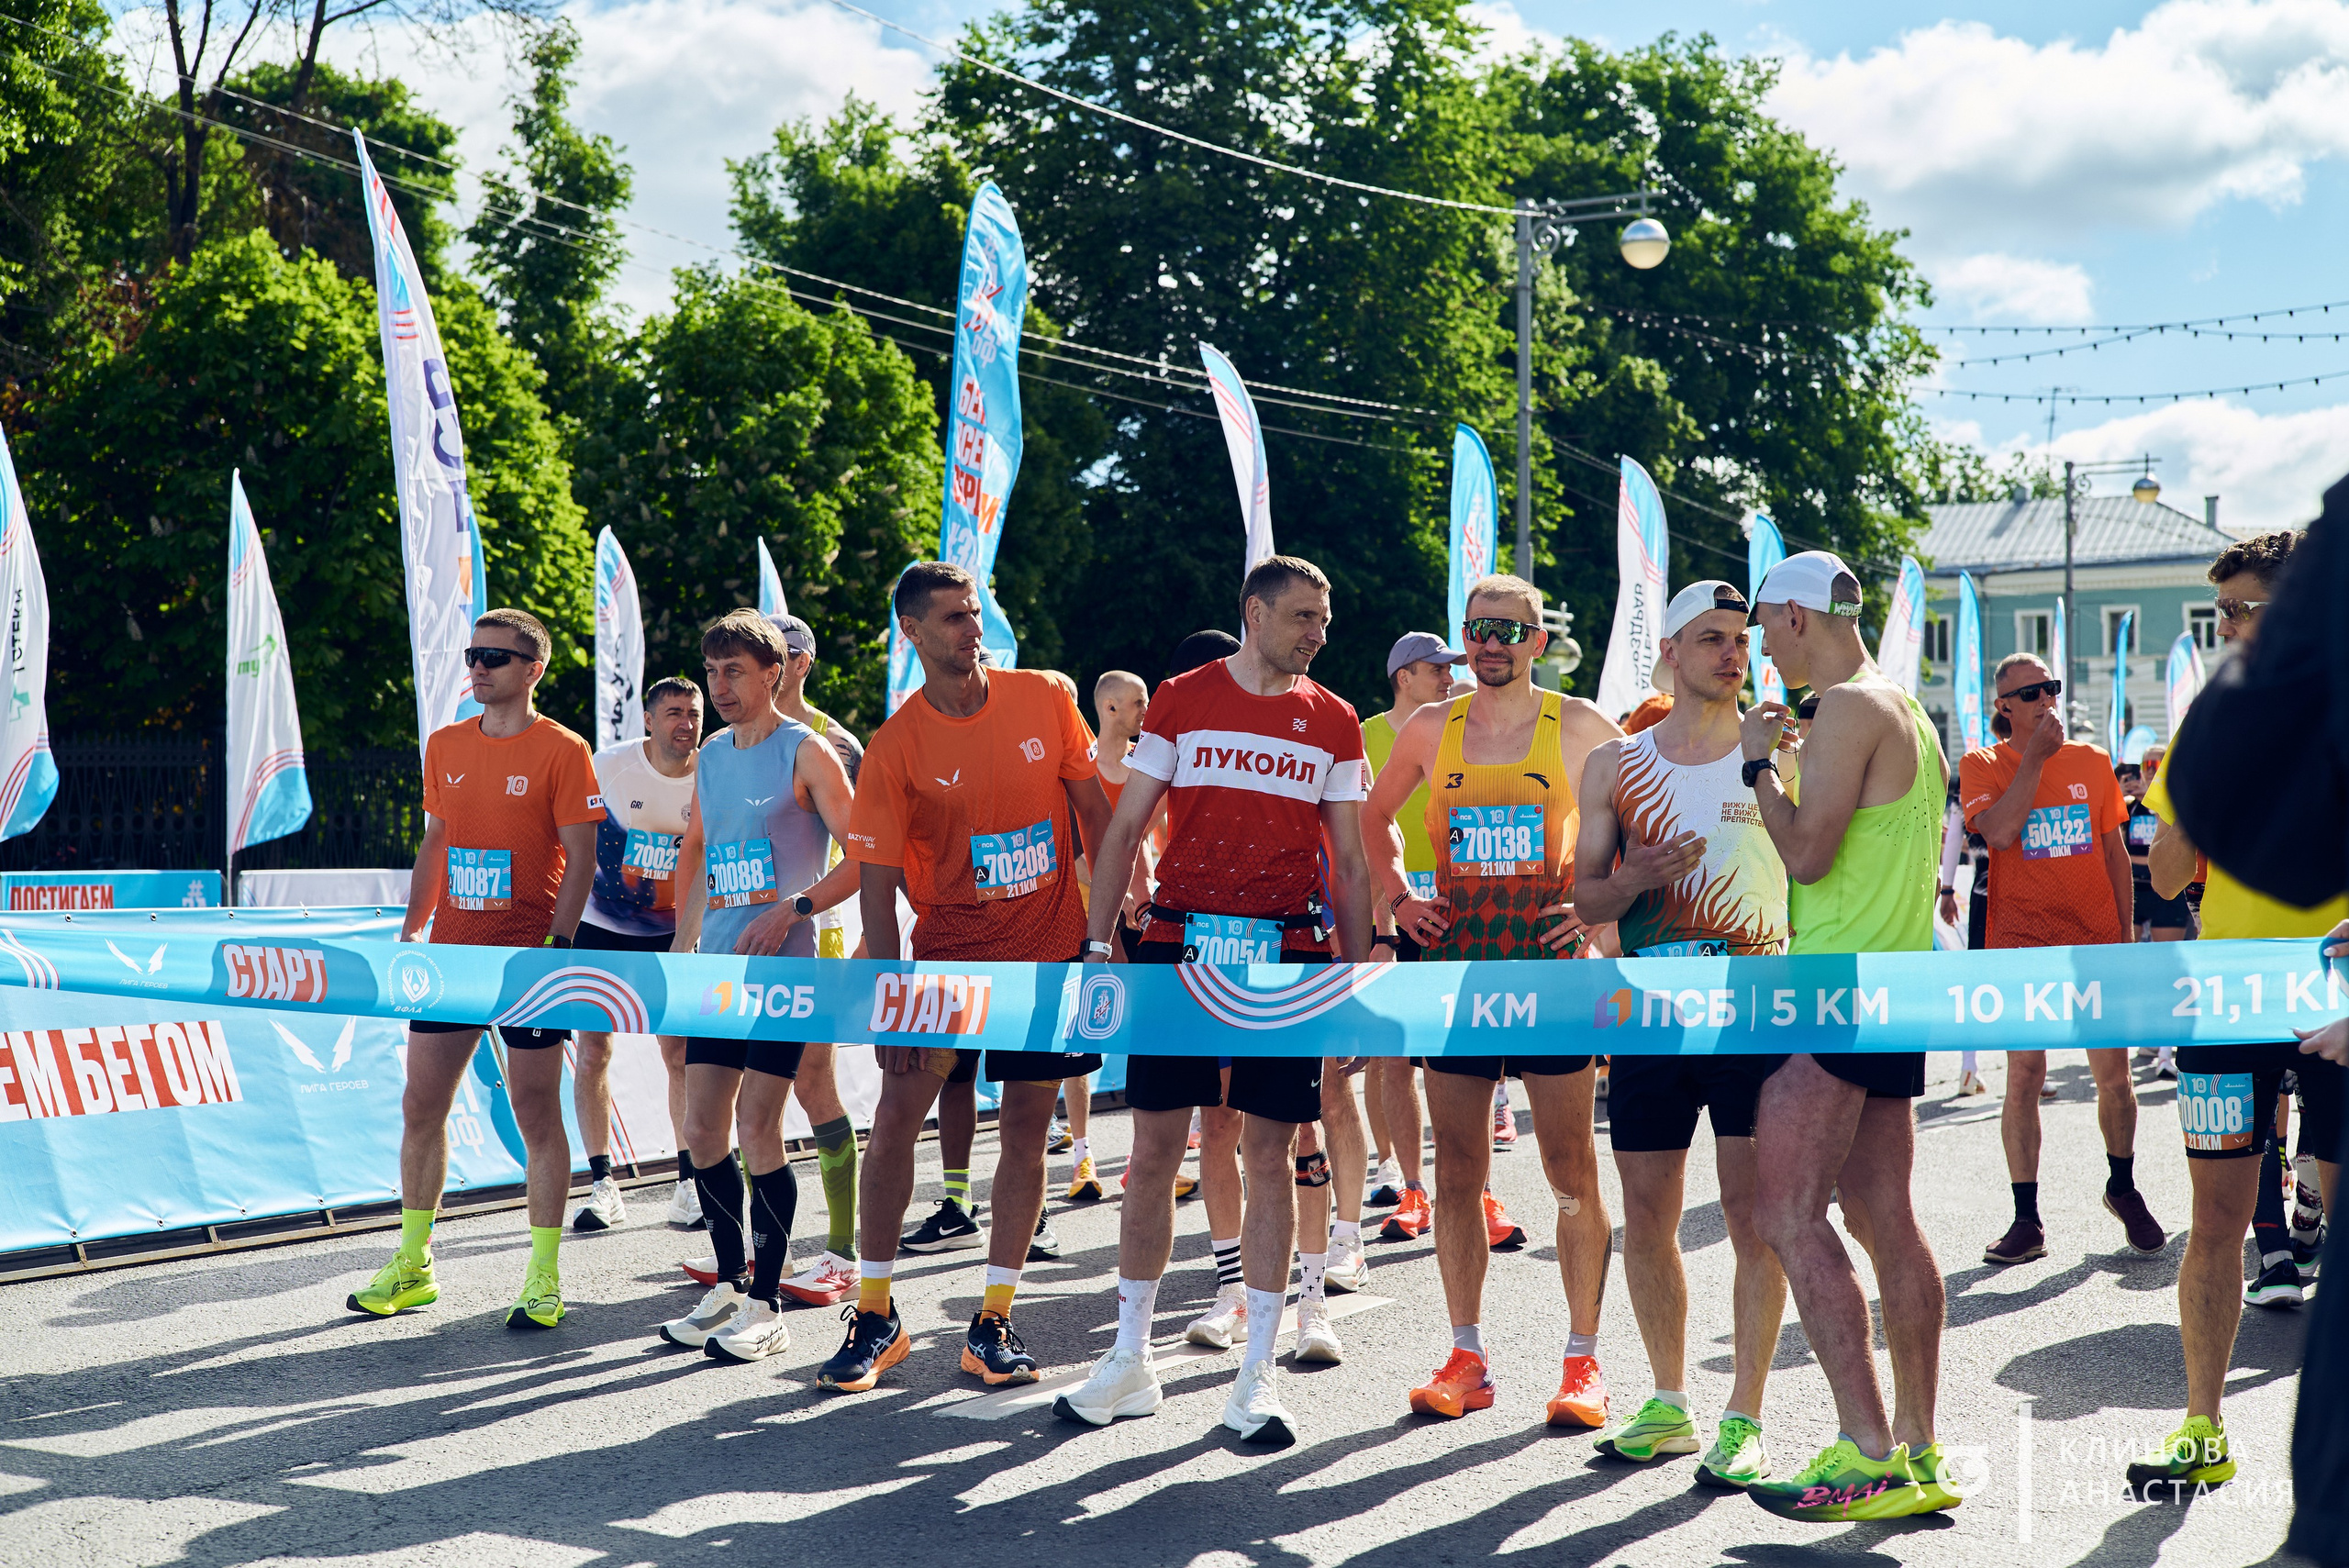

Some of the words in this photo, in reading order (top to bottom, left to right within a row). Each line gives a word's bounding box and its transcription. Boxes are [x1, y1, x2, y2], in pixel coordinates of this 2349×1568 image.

[1193, 747, 1316, 784] ЛУКОЙЛ
[1734, 809, 1757, 817] ВИЖУ
[1748, 803, 1760, 811] ЦЕ
[1463, 826, 1531, 861] 70138
[2028, 818, 2086, 848] 50422
[451, 864, 501, 896] 70087
[711, 858, 765, 895] 70088
[983, 841, 1050, 885] 70208
[1195, 935, 1269, 964] 70054
[119, 978, 139, 986] ЛИГА
[139, 980, 168, 989] ГЕРОЕВ
[223, 944, 327, 1003] СТАРТ
[394, 1006, 422, 1014] ВФЛА
[737, 983, 815, 1018] ПСБ
[869, 973, 992, 1035] СТАРТ
[1062, 973, 1126, 1040] 10
[1440, 993, 1454, 1029] 1
[1471, 992, 1537, 1028] КМ
[1641, 988, 1737, 1028] ПСБ
[1770, 989, 1797, 1027] 5
[1816, 986, 1889, 1026] КМ
[1947, 984, 2004, 1024] 10
[2023, 980, 2102, 1022] КМ
[2171, 973, 2263, 1024] 21,1
[61, 1020, 244, 1116] БЕГОМ
[300, 1083, 328, 1094] ЛИГА
[329, 1079, 370, 1092] ГЕРОЕВ
